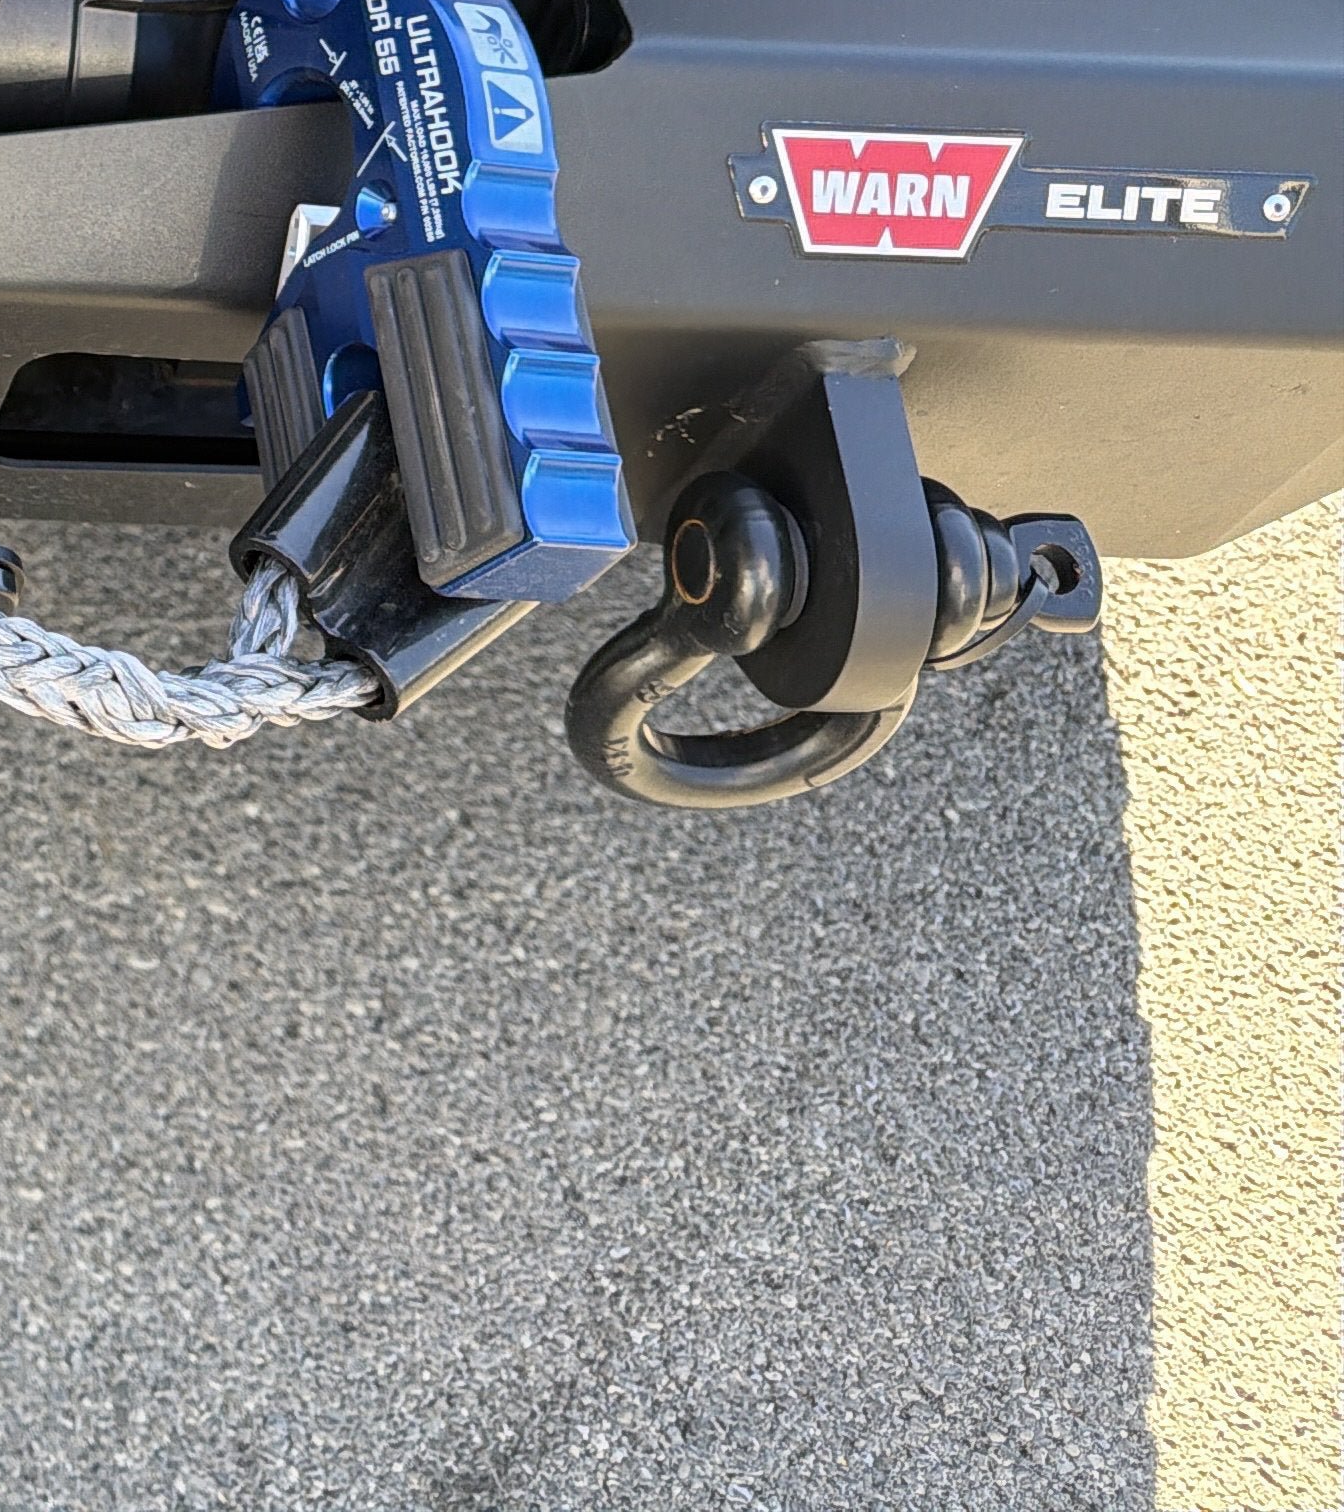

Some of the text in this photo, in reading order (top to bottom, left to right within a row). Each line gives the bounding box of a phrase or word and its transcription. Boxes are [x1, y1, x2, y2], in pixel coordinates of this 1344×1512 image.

[239, 11, 253, 46] MADE
[248, 58, 259, 83] USA
[374, 37, 401, 76] 55
[395, 80, 412, 129] PATENTED
[406, 14, 463, 196] ULTRAHOOK
[410, 99, 421, 122] MAX
[414, 121, 426, 149] LOAD
[812, 168, 971, 219] WARN
[1045, 183, 1223, 225] ELITE
[303, 248, 327, 268] LATCH
[326, 237, 347, 255] LOCK
